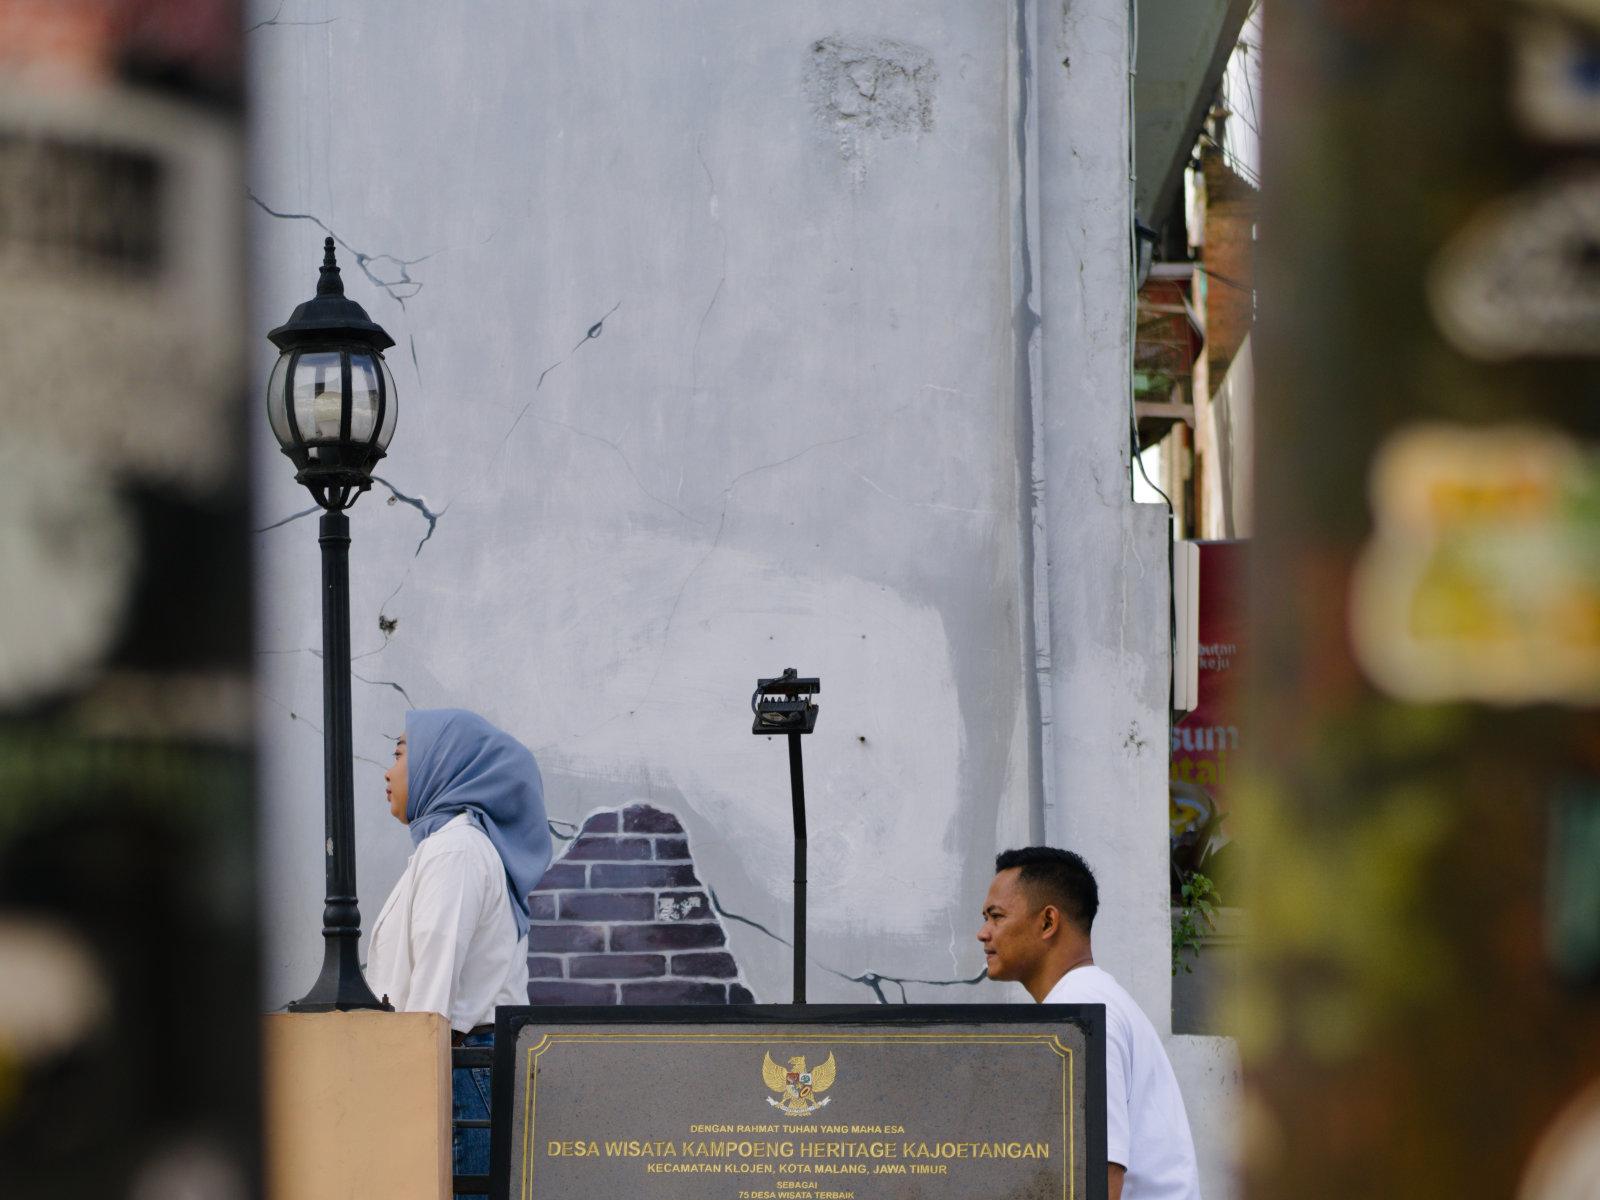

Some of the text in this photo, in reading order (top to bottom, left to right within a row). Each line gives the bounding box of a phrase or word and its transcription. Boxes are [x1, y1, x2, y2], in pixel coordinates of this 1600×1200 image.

[690, 1124, 905, 1134] DENGAN RAHMAT TUHAN YANG MAHA ESA
[547, 1141, 1050, 1158] DESA WISATA KAMPOENG HERITAGE KAJOETANGAN
[647, 1163, 948, 1176] KECAMATAN KLOJEN, KOTA MALANG, JAWA TIMUR
[776, 1181, 818, 1189] SEBAGAI
[738, 1191, 855, 1199] 75 DESA WISATA TERBAIK
